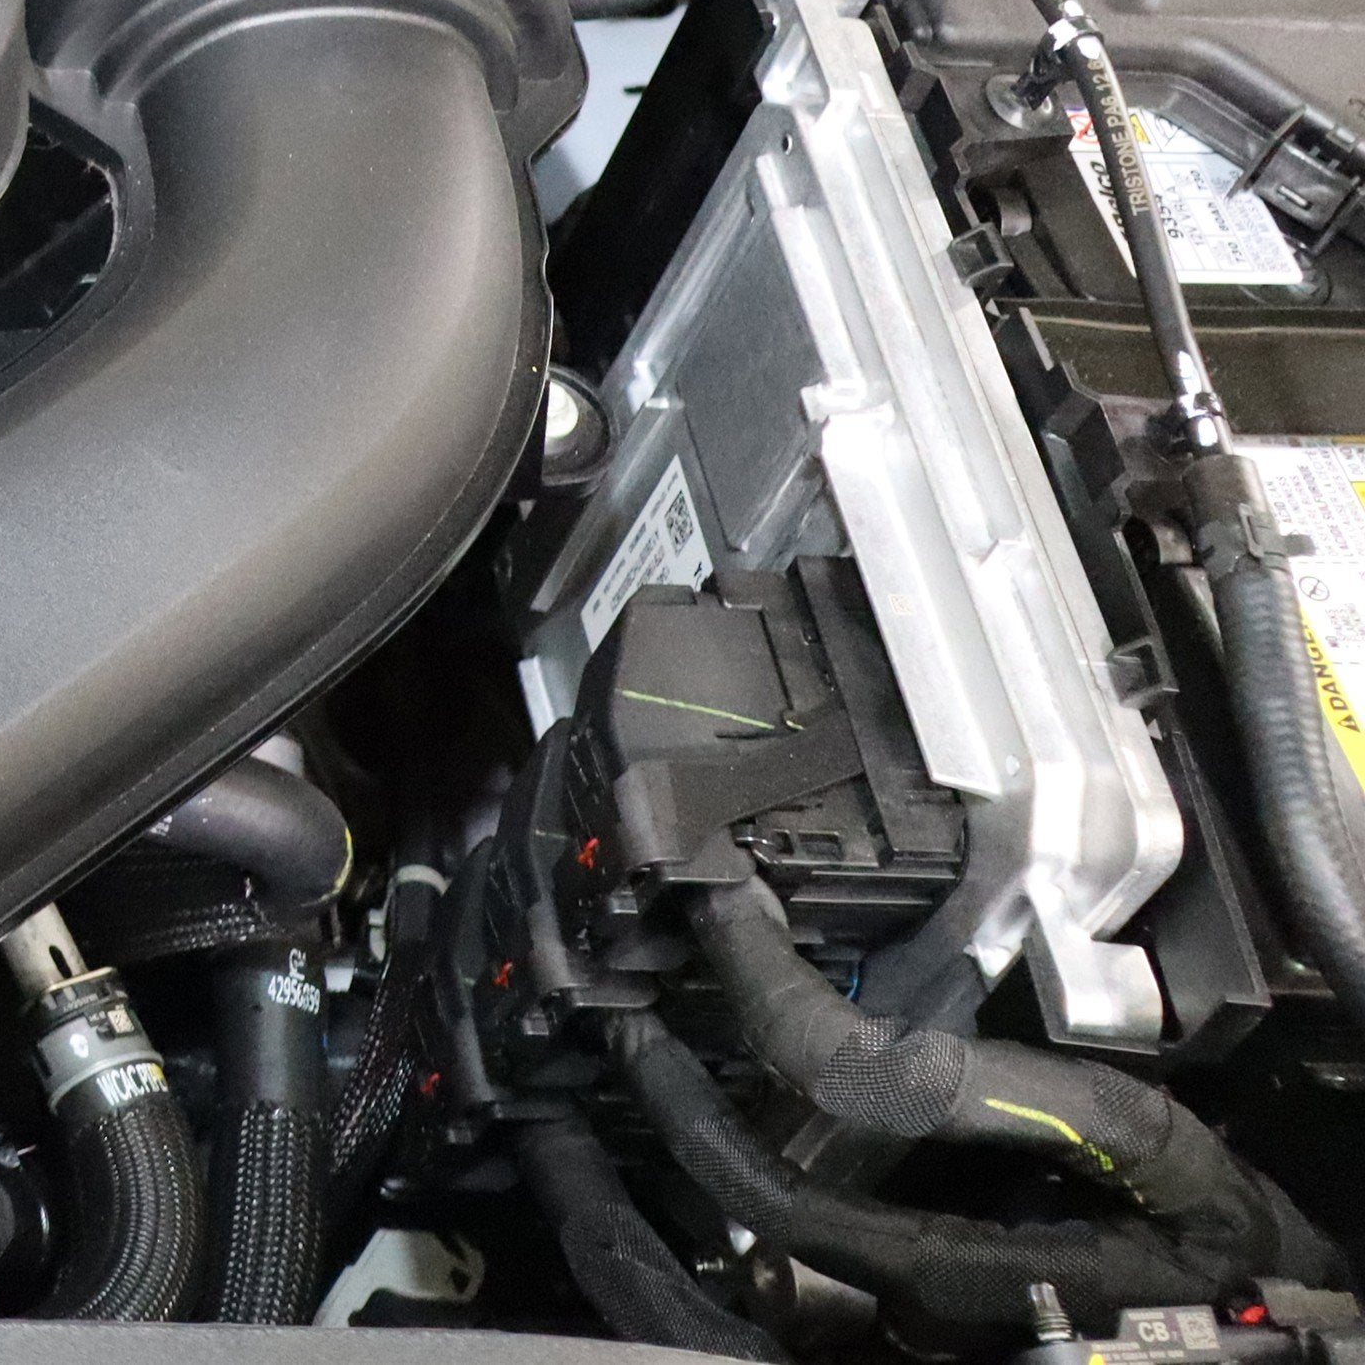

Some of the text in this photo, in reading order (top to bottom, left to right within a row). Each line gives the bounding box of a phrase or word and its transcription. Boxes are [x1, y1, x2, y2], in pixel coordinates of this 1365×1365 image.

[1112, 131, 1152, 216] TRISTONE
[1304, 624, 1349, 711] DANG
[1137, 1321, 1169, 1343] CB
